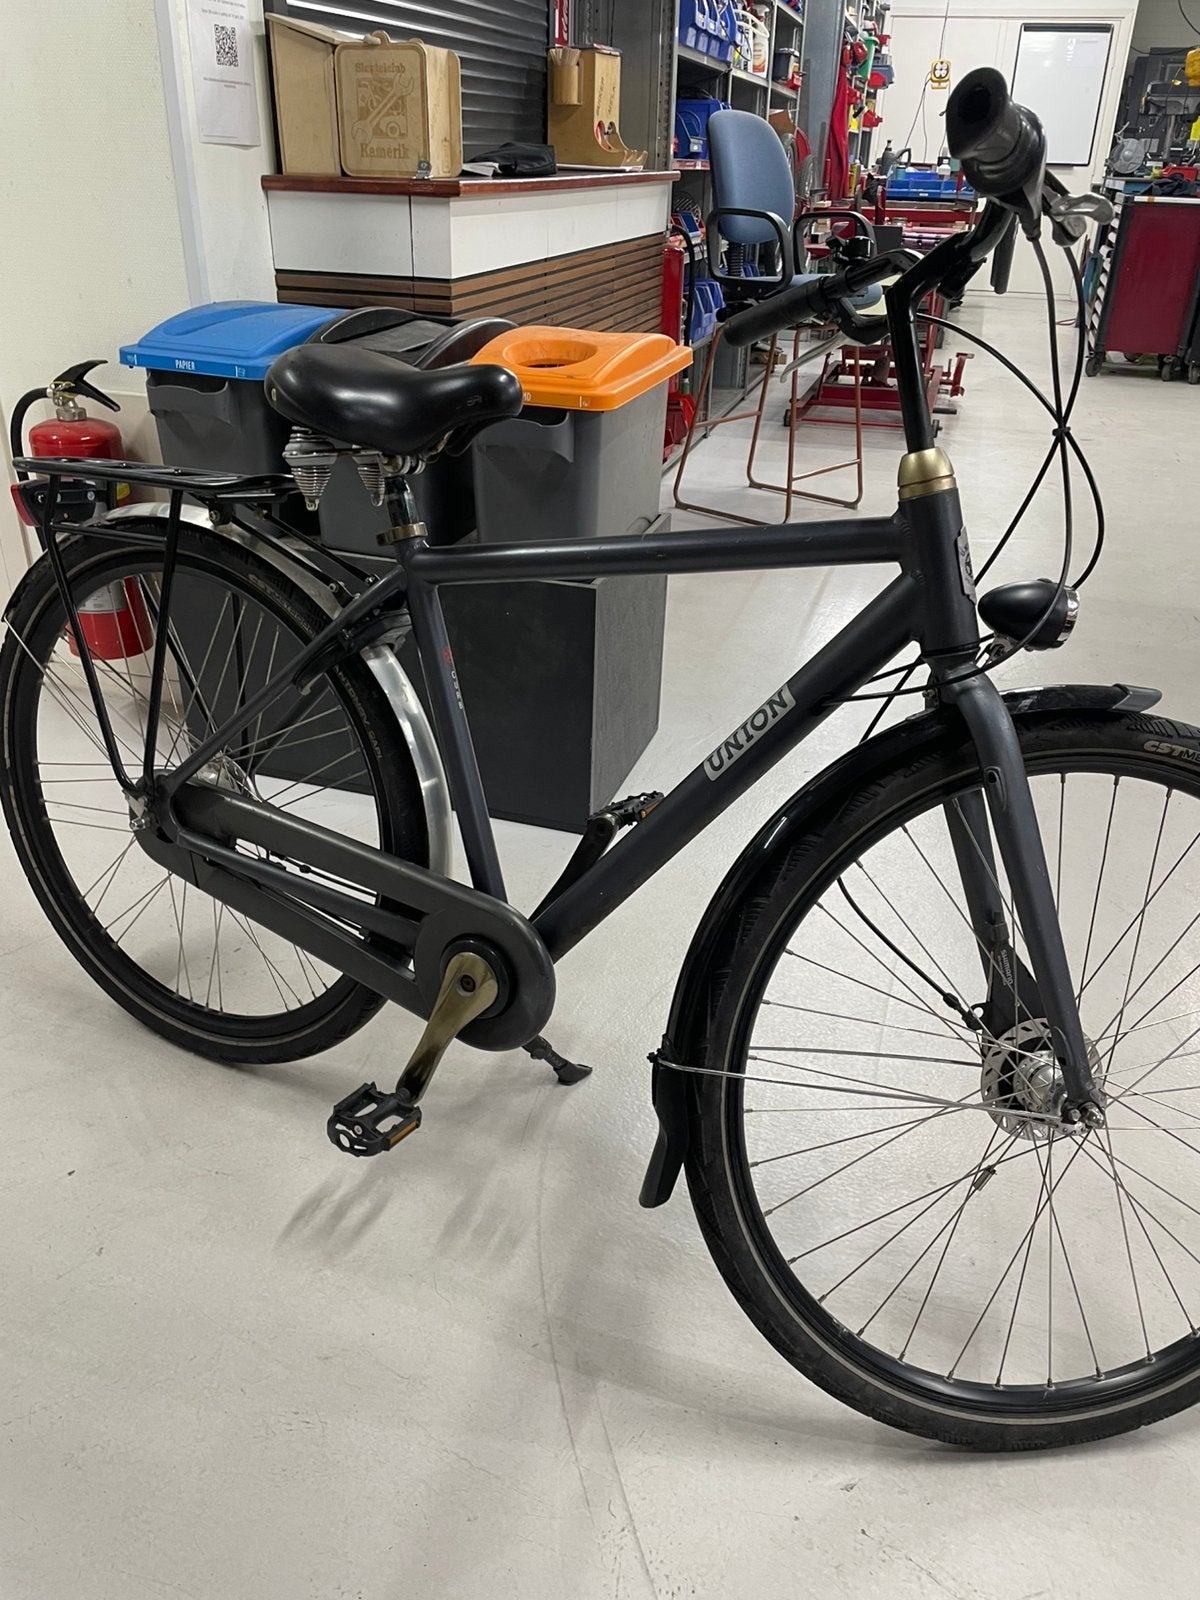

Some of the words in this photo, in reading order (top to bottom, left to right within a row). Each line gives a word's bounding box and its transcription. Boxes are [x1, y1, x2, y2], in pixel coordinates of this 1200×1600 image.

[360, 142, 410, 159] Kamerik
[175, 359, 196, 371] PAPIER
[707, 688, 788, 772] UNION
[1143, 740, 1184, 757] CST
